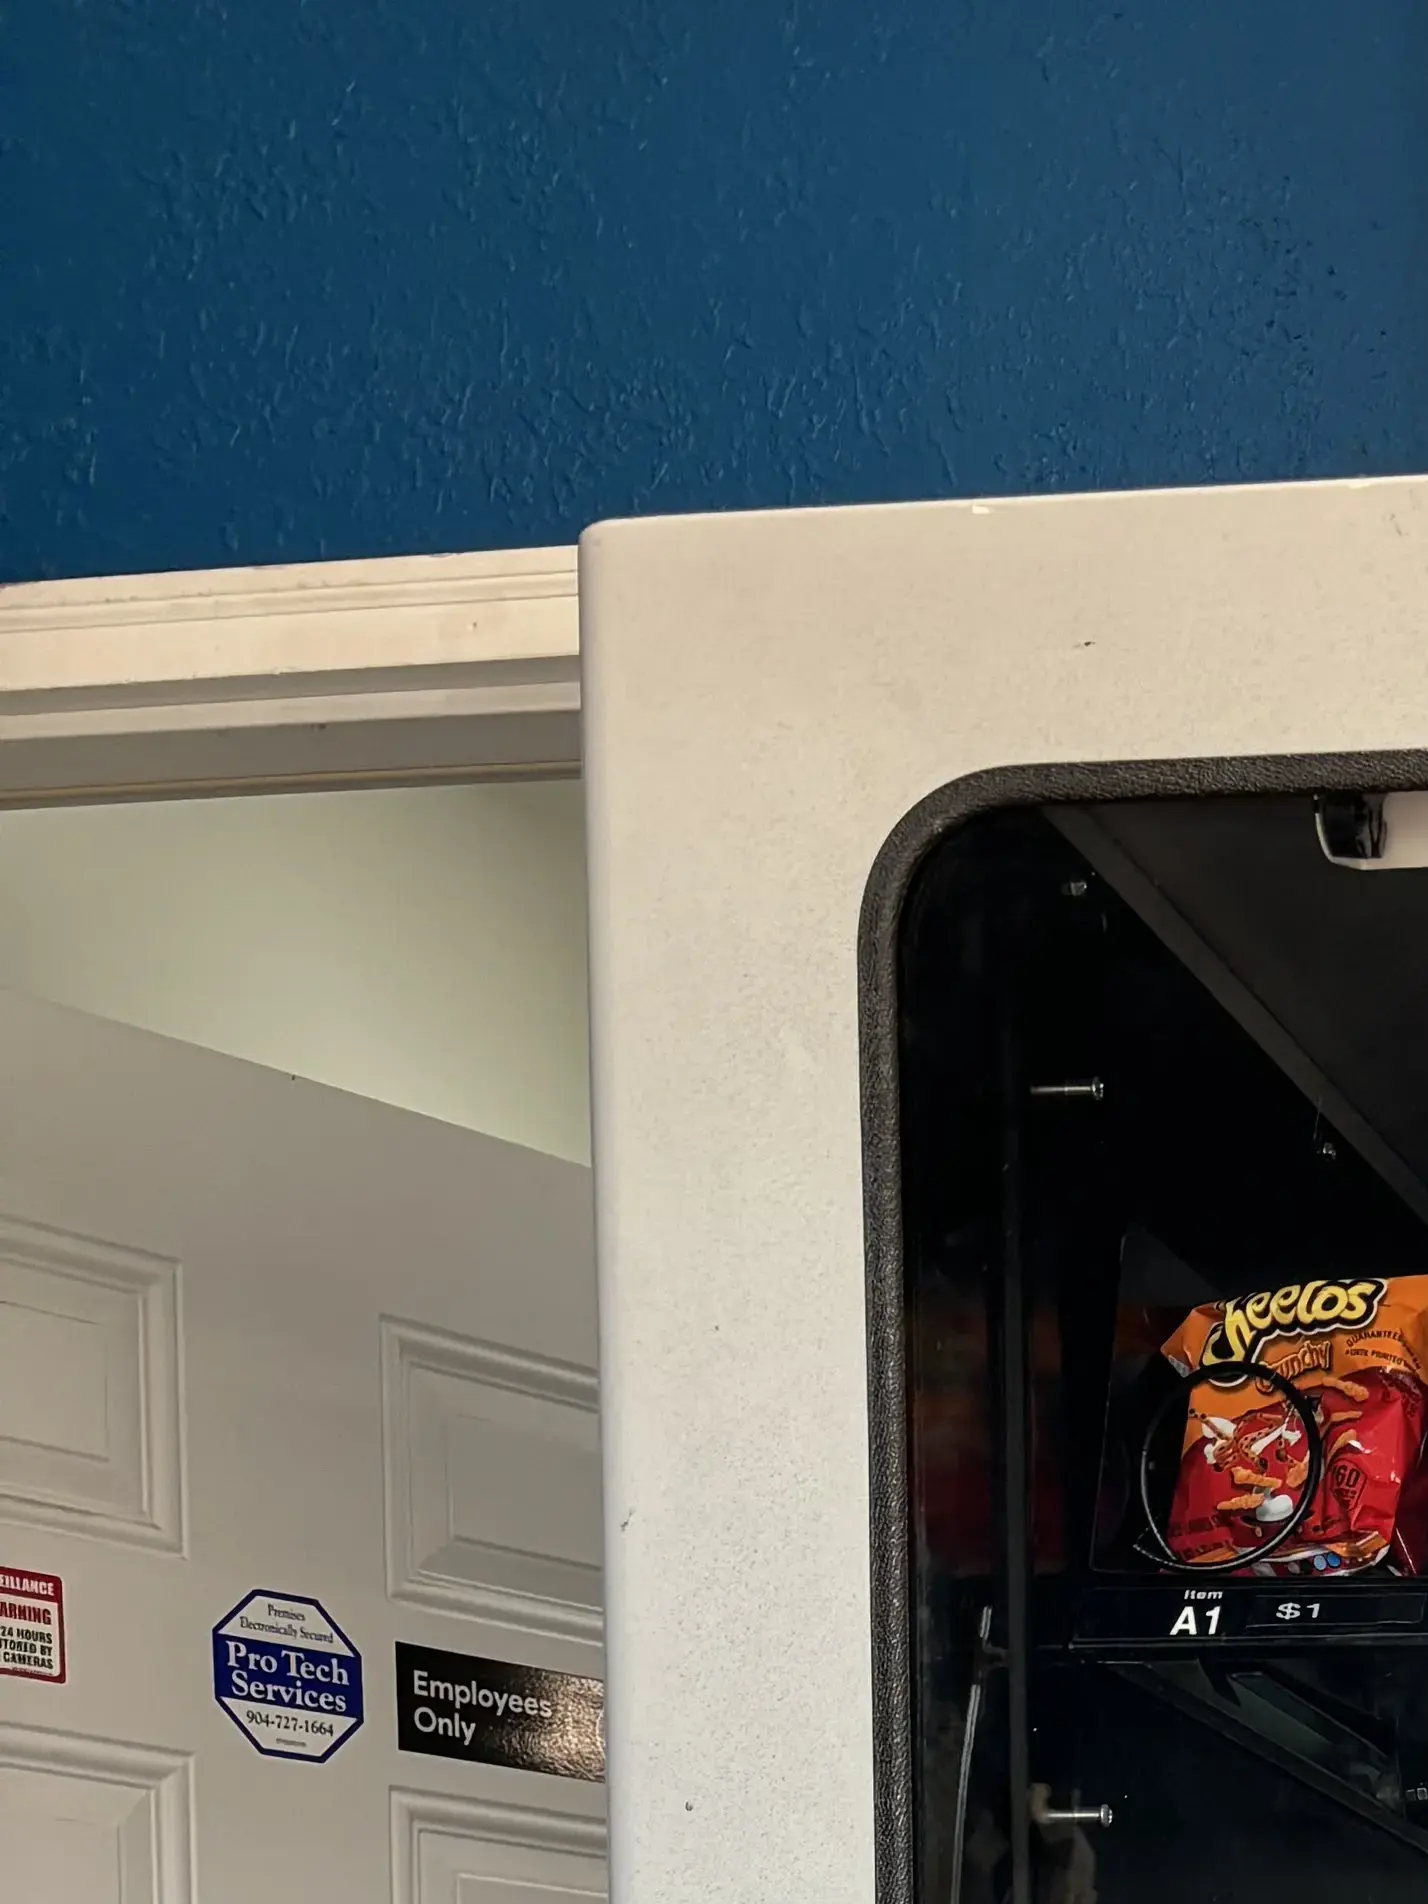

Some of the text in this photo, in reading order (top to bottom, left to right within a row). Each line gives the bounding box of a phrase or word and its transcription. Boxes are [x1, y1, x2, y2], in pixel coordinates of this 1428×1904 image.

[1202, 1281, 1379, 1366] Cheetos
[240, 1616, 334, 1645] Electronically Secured
[268, 1603, 305, 1622] Premises
[1170, 1602, 1322, 1636] A1 $1
[3, 1652, 53, 1669] CAMERAS
[227, 1641, 349, 1687] Pro Tech
[231, 1671, 346, 1713] Services
[413, 1671, 552, 1719] Employees
[246, 1709, 334, 1737] 904-727-1664
[414, 1707, 477, 1747] Only
